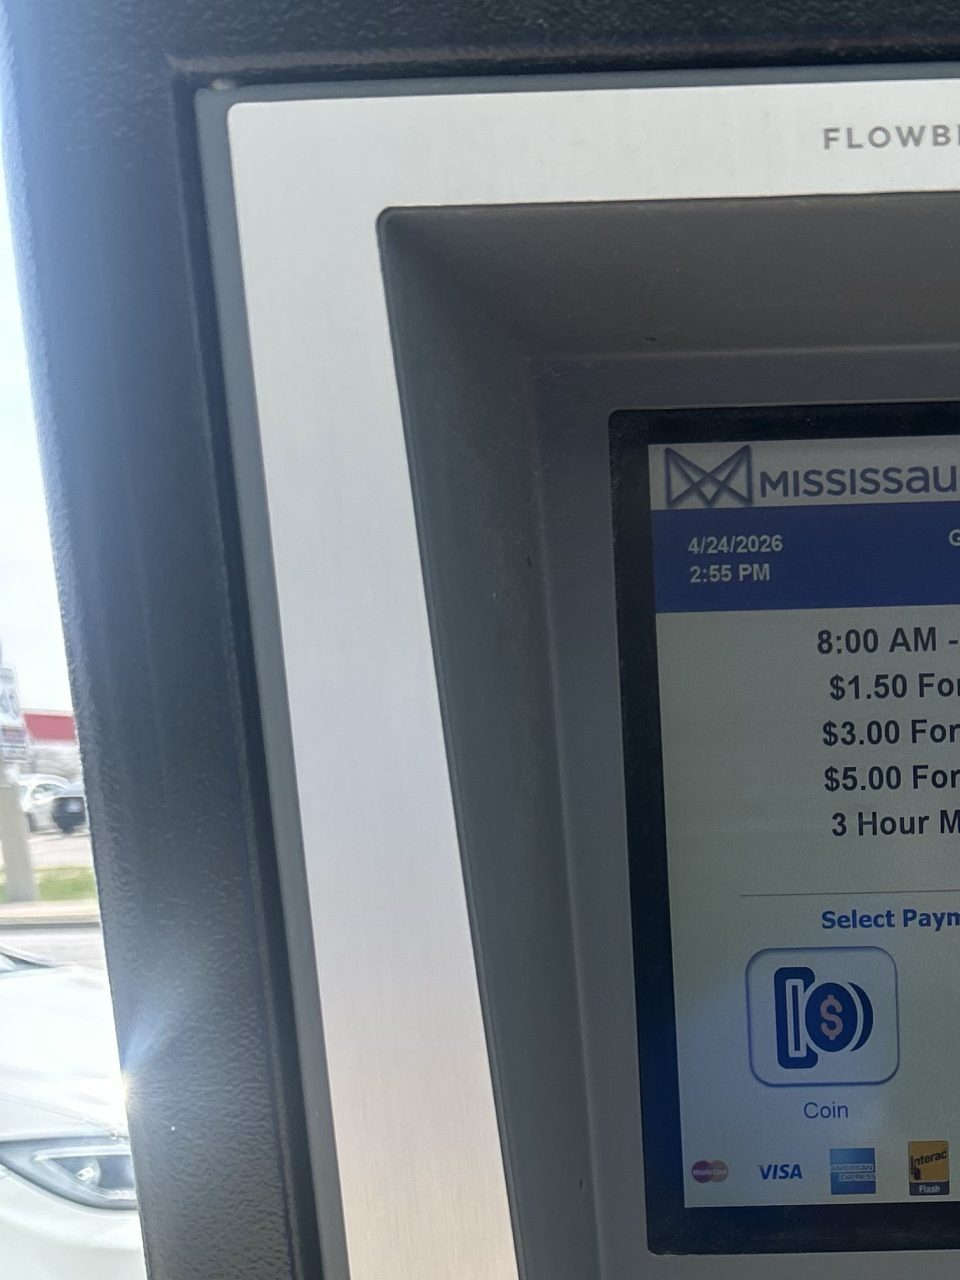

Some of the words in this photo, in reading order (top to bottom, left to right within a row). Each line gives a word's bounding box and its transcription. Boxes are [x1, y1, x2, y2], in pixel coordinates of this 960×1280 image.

[687, 533, 784, 555] 4/24/2026
[689, 566, 733, 583] 2:55
[738, 564, 771, 582] PM
[816, 628, 879, 655] 8:00
[888, 627, 937, 652] AM
[828, 674, 908, 702] $1.50
[821, 720, 900, 748] $3.00
[910, 719, 960, 745] For
[823, 766, 902, 794] $5.00
[831, 813, 847, 837] 3
[857, 810, 930, 836] Hour
[820, 909, 896, 929] Select
[803, 1101, 850, 1121] Coin
[757, 1163, 803, 1180] VISA
[839, 1173, 877, 1182] EXPRESS
[918, 1183, 941, 1194] Flash
